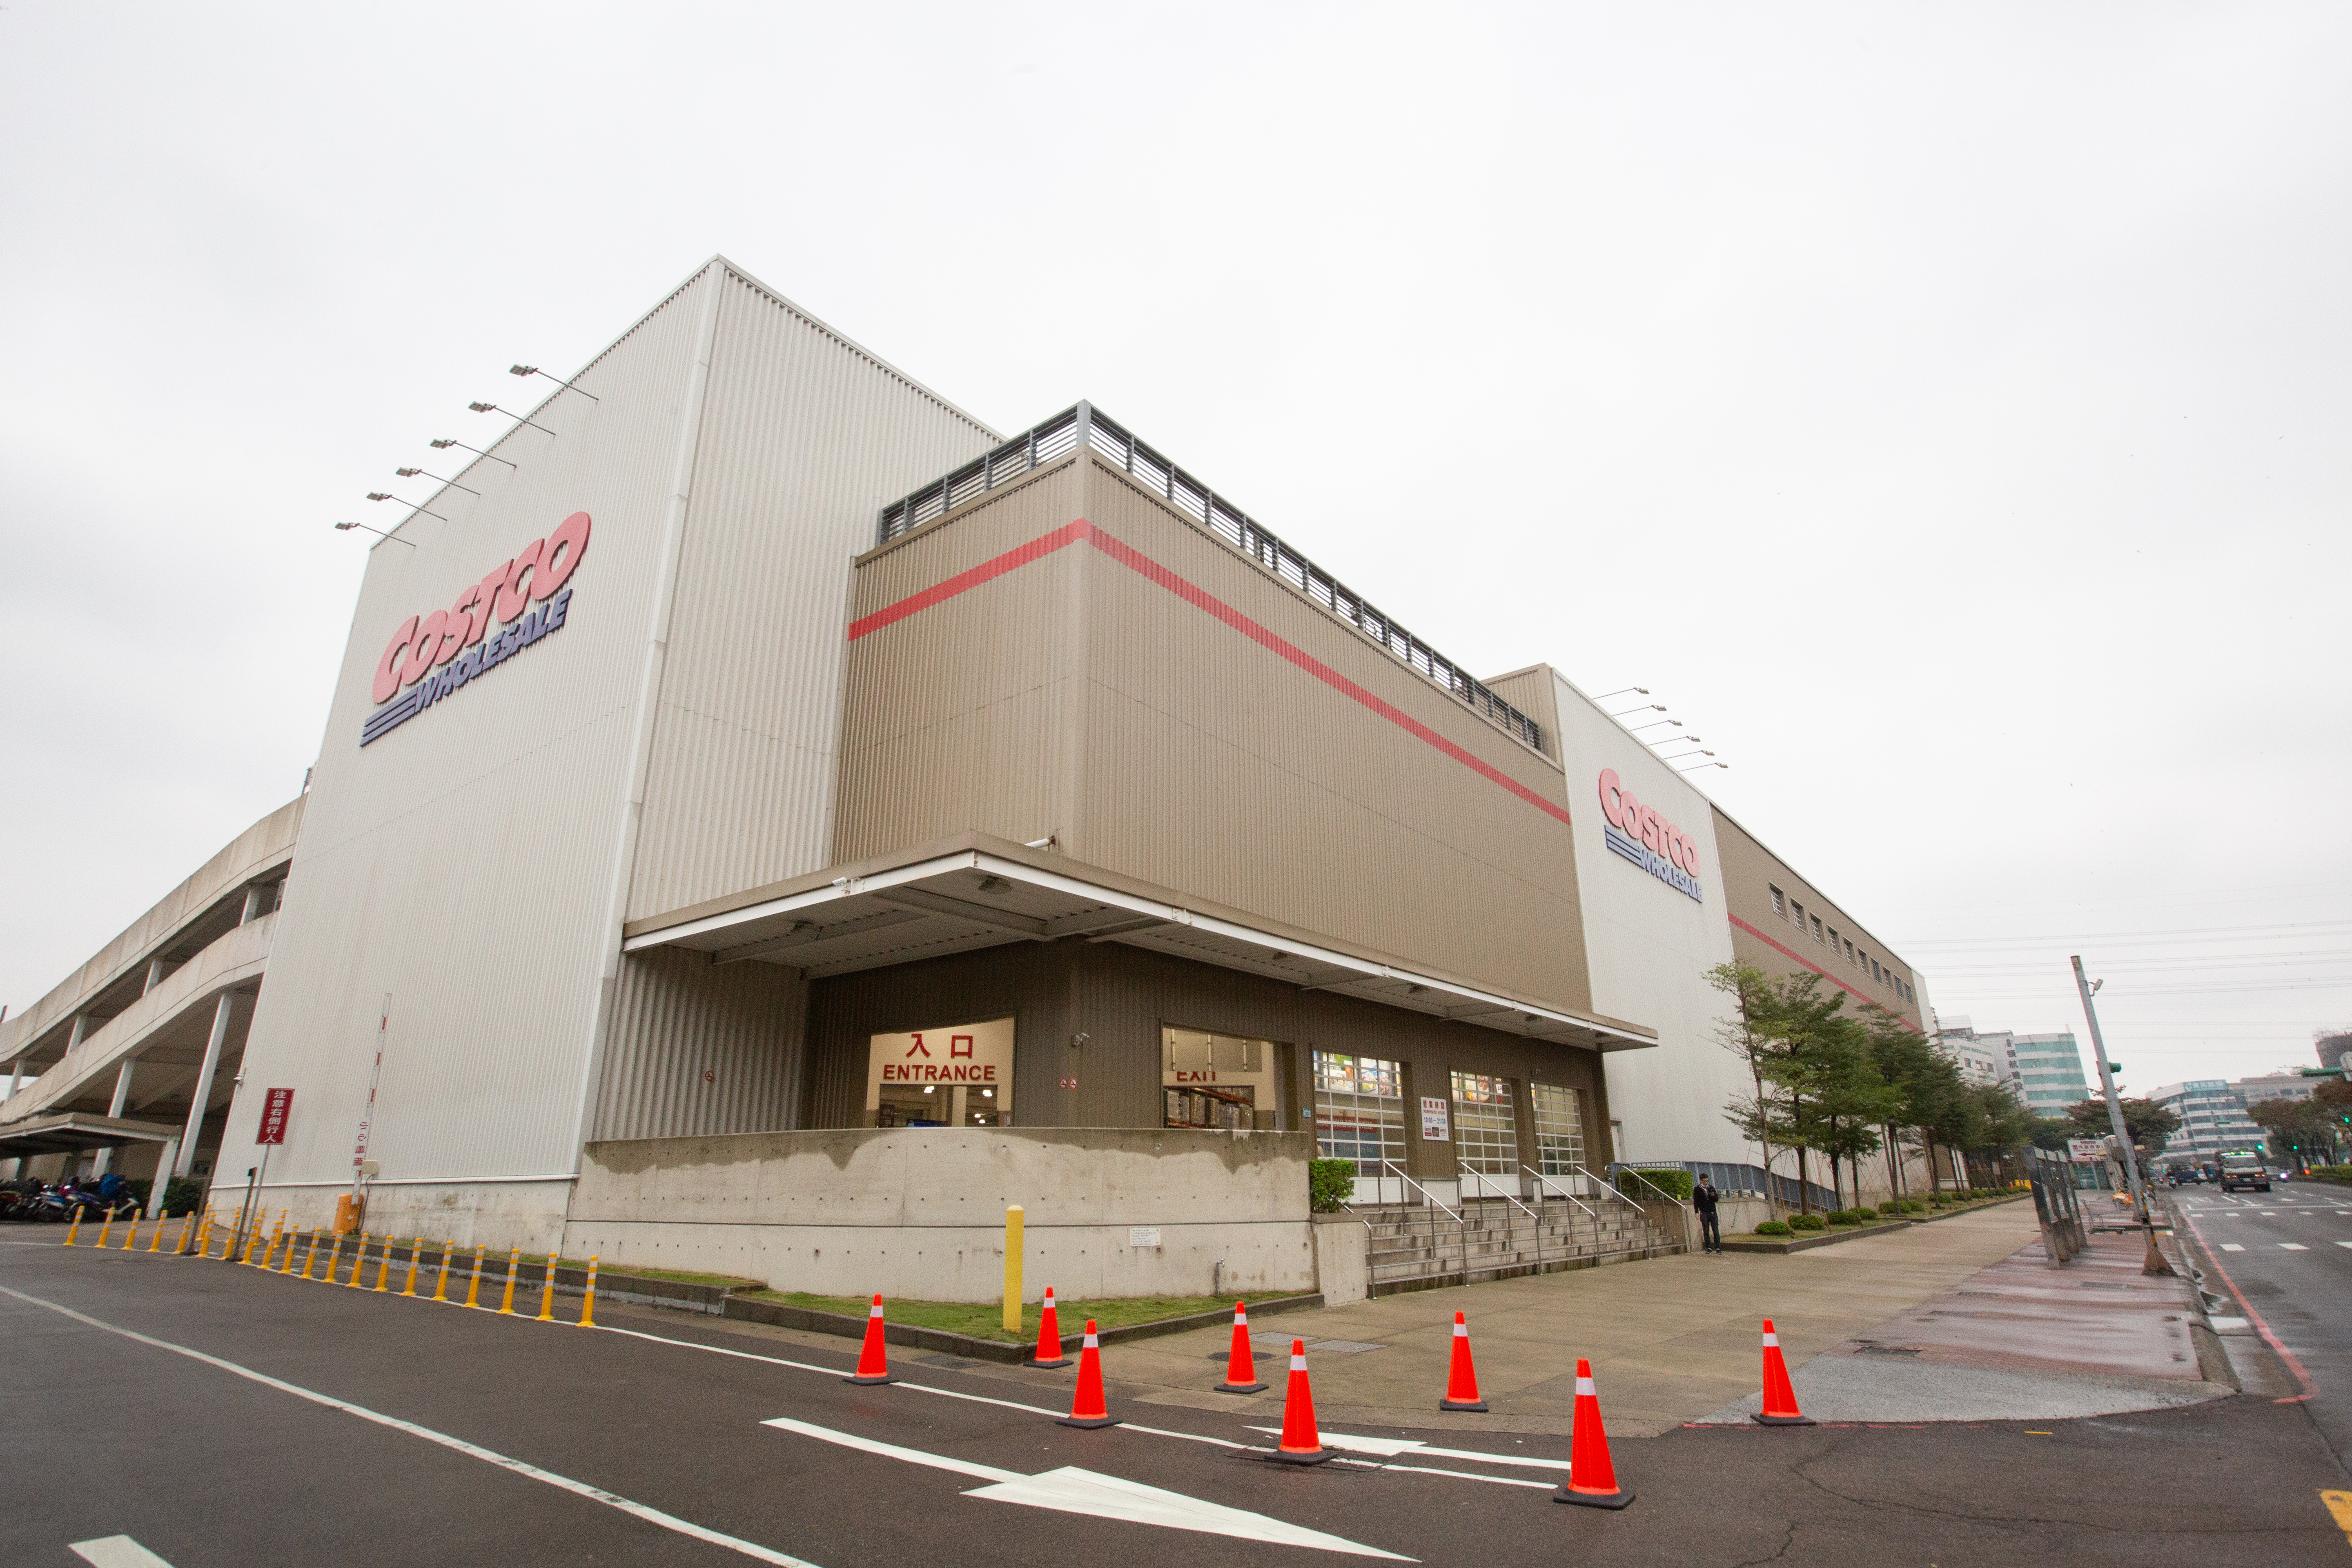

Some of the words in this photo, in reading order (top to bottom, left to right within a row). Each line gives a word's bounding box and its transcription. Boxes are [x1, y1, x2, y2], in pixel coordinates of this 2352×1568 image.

[372, 511, 591, 704] COSTCO
[414, 588, 573, 713] WHOLESALE
[1599, 768, 1700, 877] COSTCO
[1638, 845, 1702, 903] WHOLESALE
[883, 1064, 996, 1081] ENTRANCE
[906, 1033, 973, 1059] 入口
[263, 1090, 287, 1143] 注意右側行人
